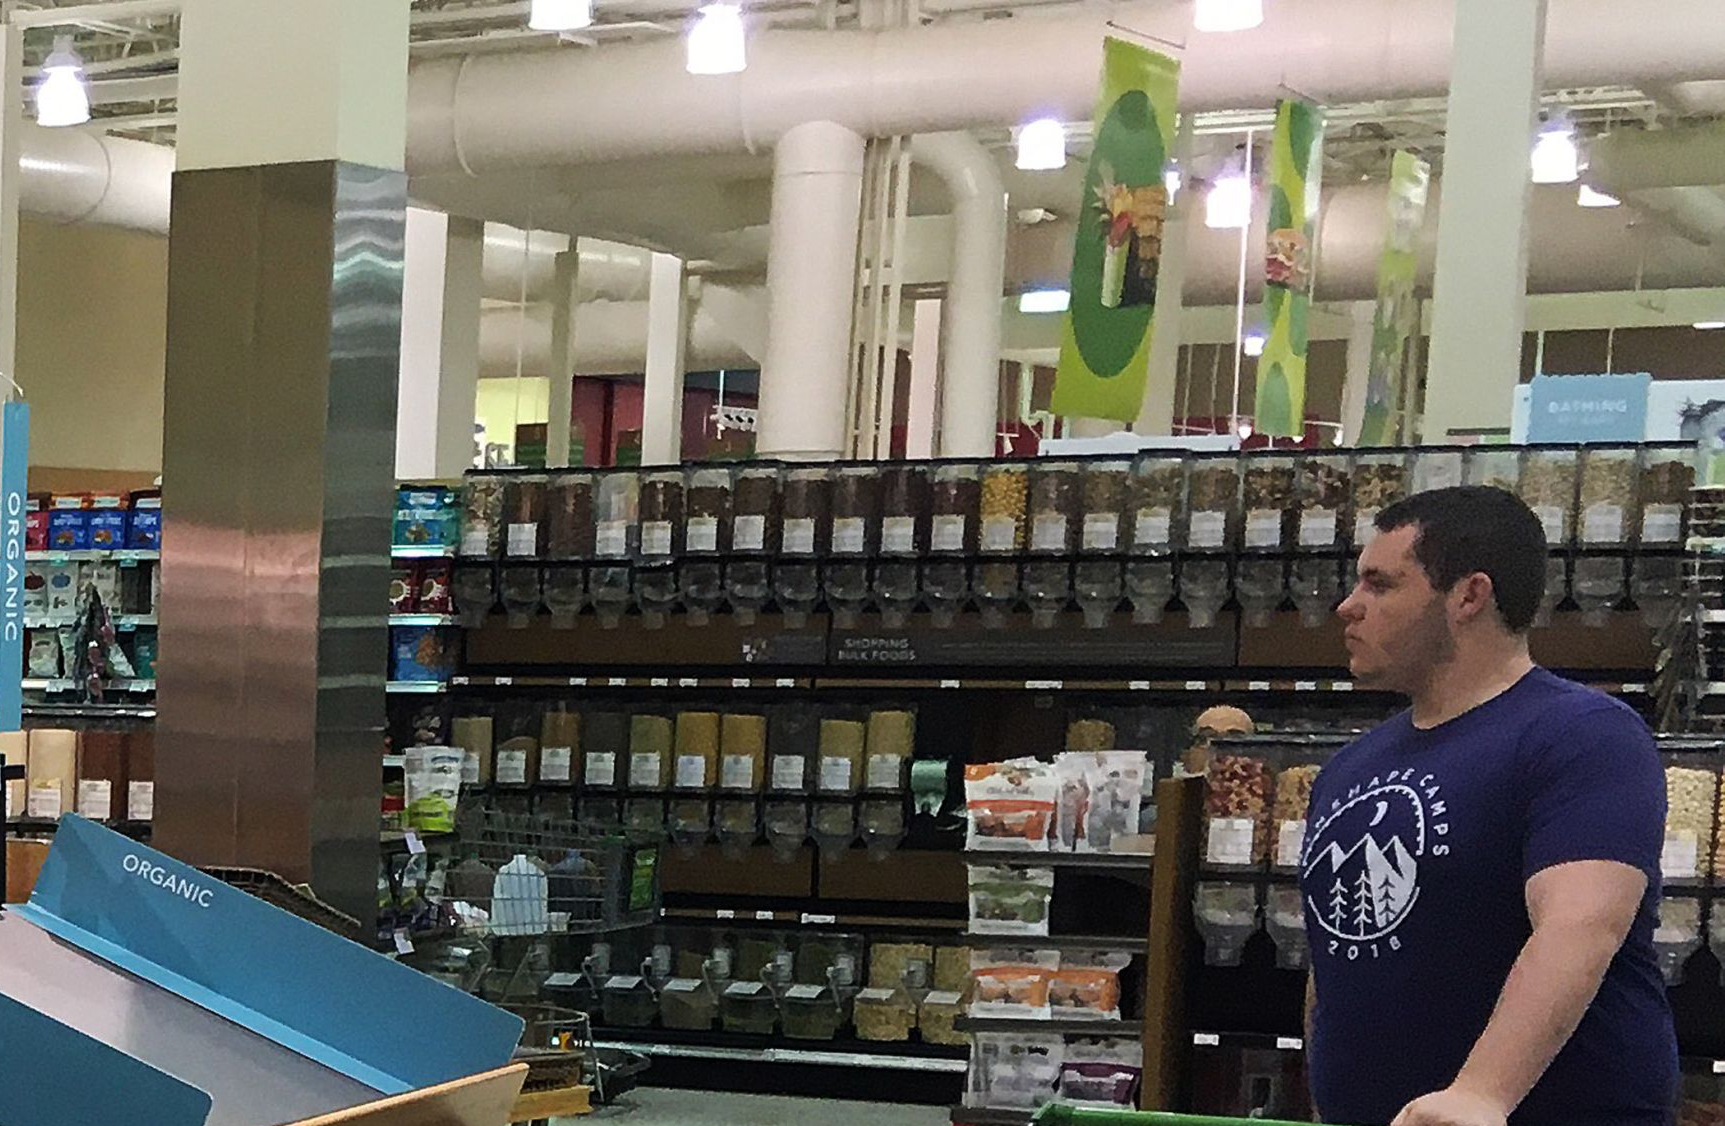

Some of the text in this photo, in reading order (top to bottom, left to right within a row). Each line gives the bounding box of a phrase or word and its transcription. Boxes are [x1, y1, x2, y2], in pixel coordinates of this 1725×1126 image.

[4, 491, 22, 643] ORGANIC
[845, 638, 909, 649] SHOPPING
[872, 650, 916, 661] FOODS
[1419, 774, 1450, 857] CAMPS
[121, 851, 216, 911] ORGANIC
